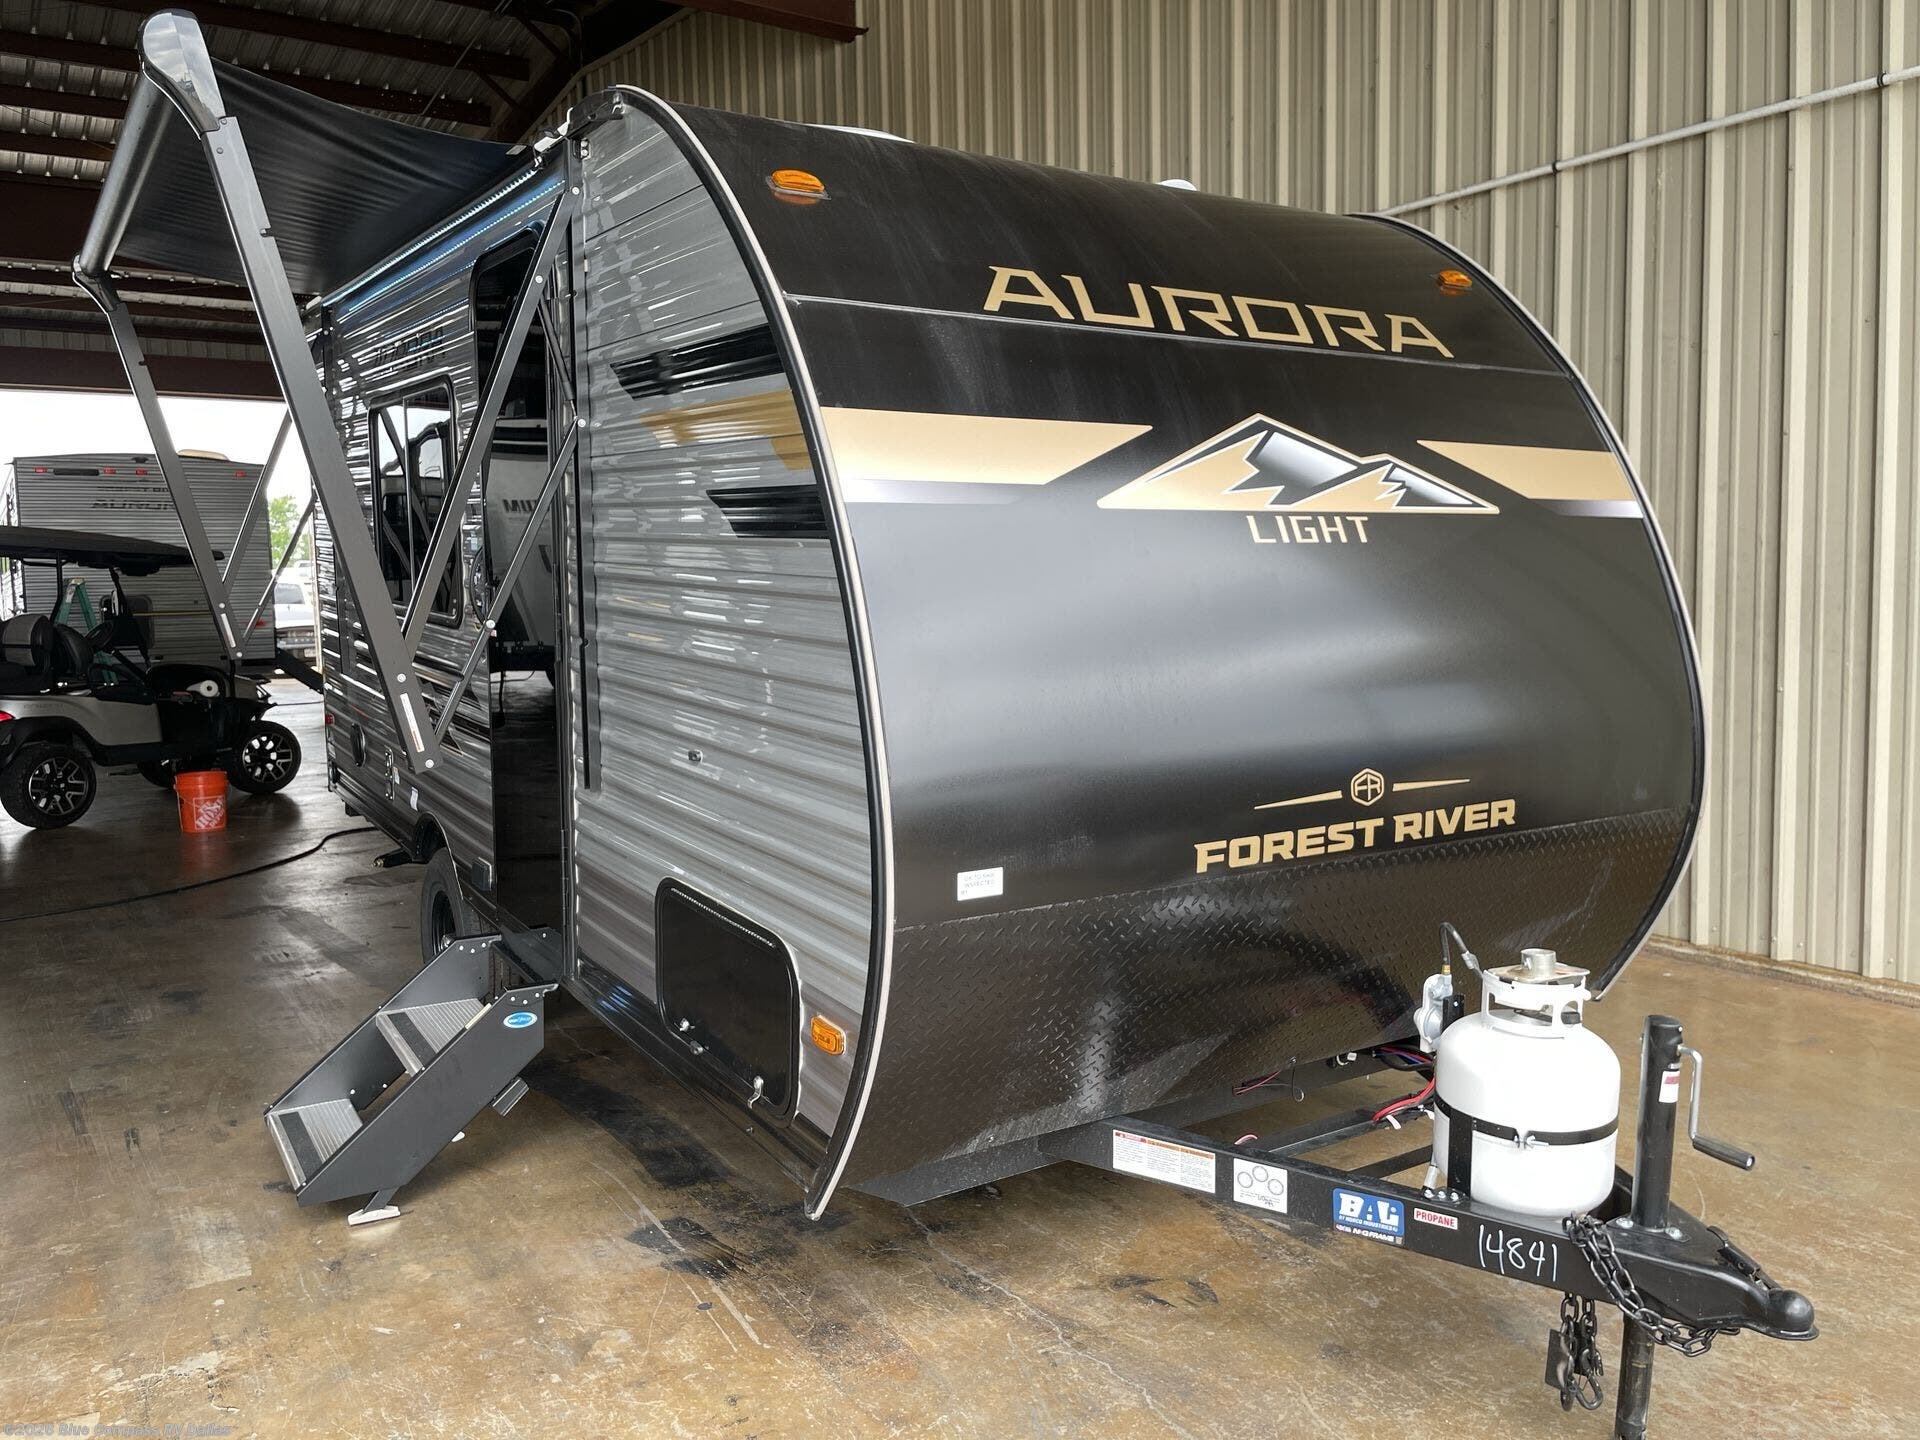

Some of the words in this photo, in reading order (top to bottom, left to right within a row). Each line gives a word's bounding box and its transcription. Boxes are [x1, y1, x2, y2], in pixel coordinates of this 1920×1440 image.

[983, 266, 1455, 358] AURORA
[1246, 515, 1368, 543] LIGHT
[1194, 817, 1384, 873] FOREST
[1393, 799, 1516, 843] RIVER
[1415, 1210, 1455, 1227] PROPANE
[1478, 1224, 1558, 1282] 14841
